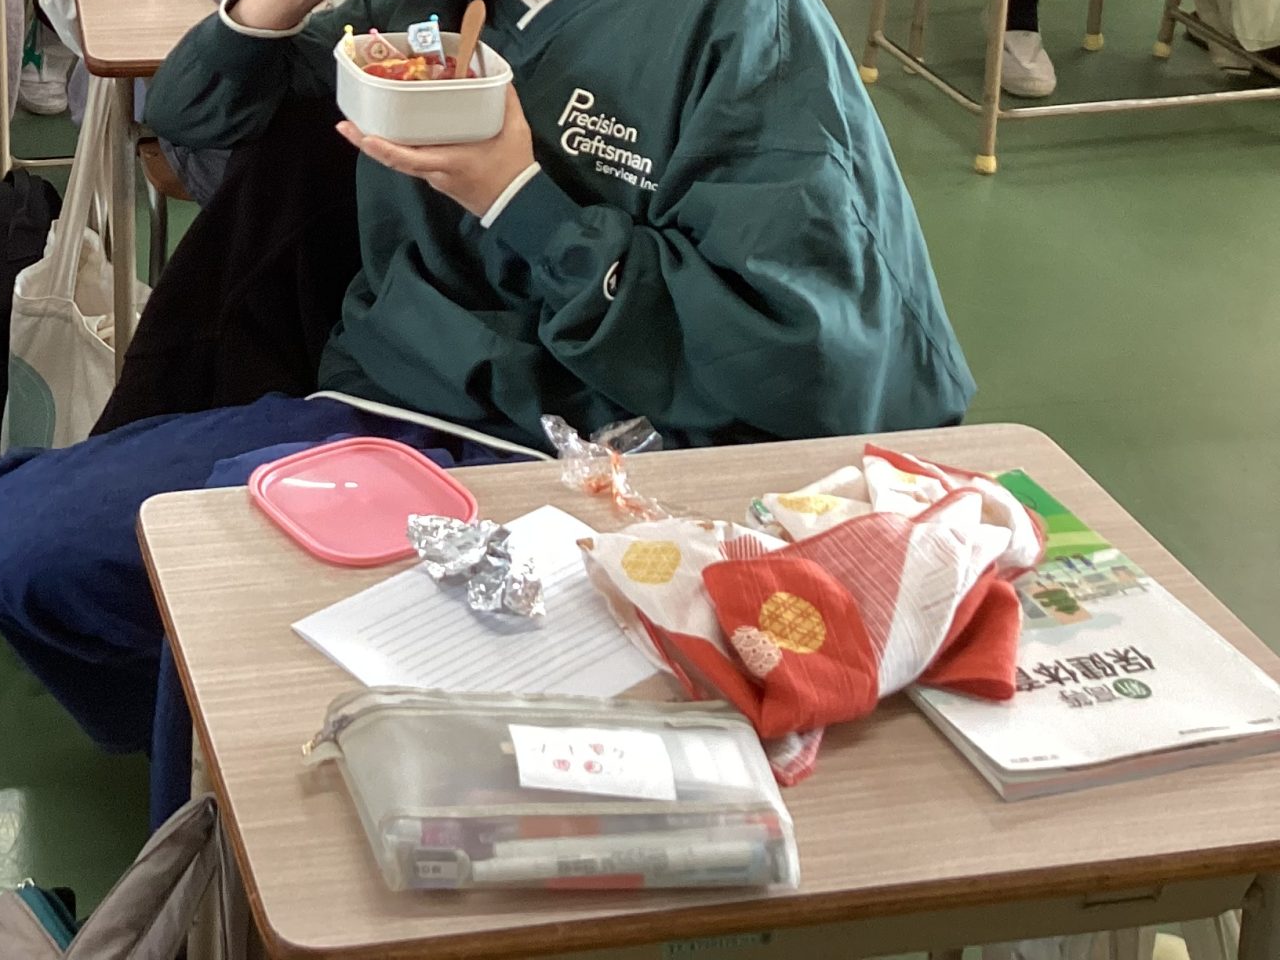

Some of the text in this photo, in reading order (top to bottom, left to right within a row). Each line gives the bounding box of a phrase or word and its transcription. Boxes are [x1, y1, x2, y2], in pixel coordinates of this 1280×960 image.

[557, 87, 638, 143] Precision
[560, 126, 653, 174] Craftsman
[595, 161, 659, 192] Services Inc
[1015, 645, 1155, 692] 保健体育
